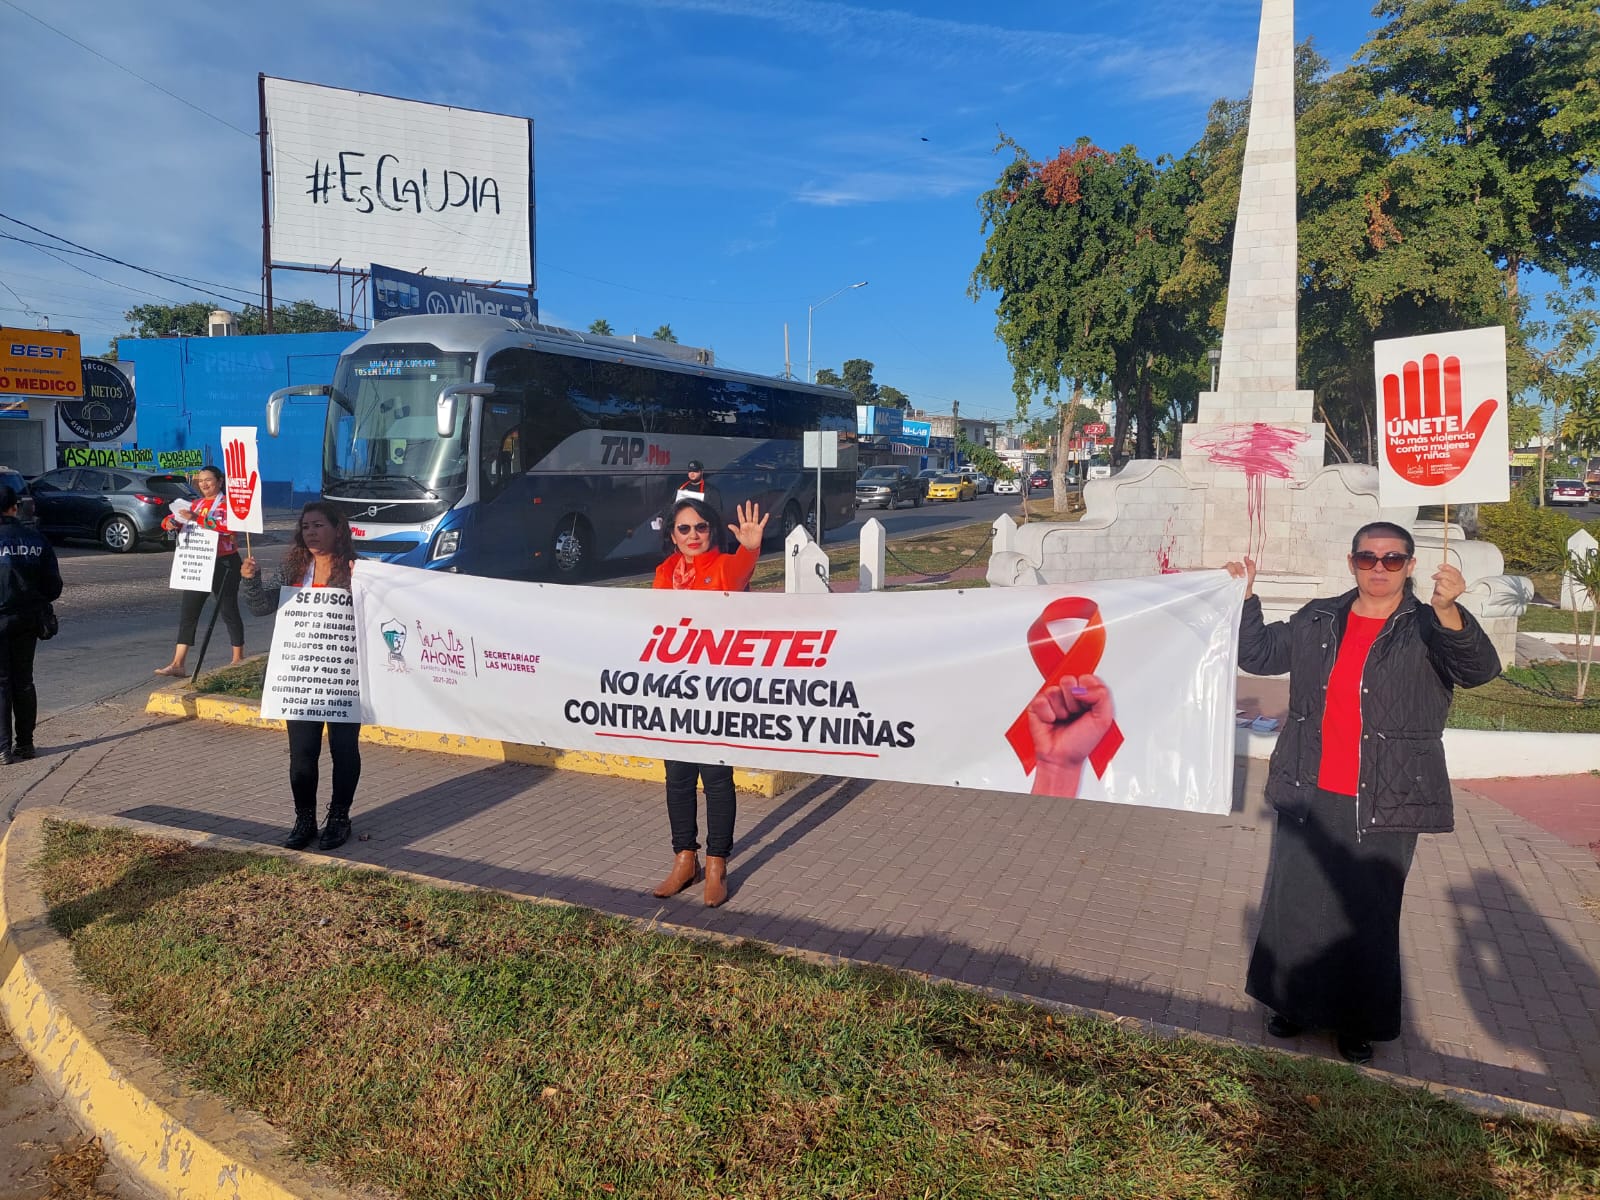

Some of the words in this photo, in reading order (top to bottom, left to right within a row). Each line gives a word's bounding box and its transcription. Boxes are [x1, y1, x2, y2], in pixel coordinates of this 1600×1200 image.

[10, 344, 67, 359] BEST
[15, 377, 77, 392] MEDICO
[91, 384, 123, 399] NIETOS
[902, 426, 928, 436] NI-LAB
[1387, 416, 1459, 437] ÚNETE
[1390, 437, 1405, 446] No
[1407, 434, 1428, 445] más
[1430, 431, 1476, 443] violencia
[600, 435, 645, 466] TAP
[1396, 443, 1428, 454] contra
[1430, 440, 1470, 452] mujeres
[66, 448, 117, 468] ASADA
[120, 448, 154, 462] BURROS
[159, 449, 203, 463] ADOBADA
[1415, 454, 1422, 463] y
[1423, 450, 1451, 460] niñas
[351, 526, 366, 537] Plus
[0, 545, 42, 557] ALIDAD
[295, 591, 311, 605] SE
[313, 592, 353, 607] BUSCA
[284, 609, 324, 619] Hombres
[326, 612, 344, 621] que
[294, 620, 310, 629] por
[312, 621, 321, 629] la
[323, 622, 356, 632] igualda
[295, 631, 306, 639] de
[308, 632, 350, 642] hombres
[639, 617, 838, 668] ¡ÚNETE!
[283, 641, 324, 651] mujeres
[326, 644, 338, 652] en
[281, 653, 296, 661] los
[298, 654, 342, 665] aspectos
[344, 657, 354, 665] de
[420, 649, 466, 670] AHOME
[321, 666, 339, 675] que
[485, 660, 499, 670] LAS
[501, 662, 536, 674] MUJERES
[277, 674, 344, 686] comprometan
[271, 685, 312, 694] eliminar
[314, 687, 323, 695] la
[326, 688, 360, 697] violenci
[600, 669, 639, 696] NO
[643, 670, 701, 701] MÁS
[705, 676, 860, 709] VIOLENCIA
[282, 696, 309, 705] hacia
[310, 698, 326, 707] las
[289, 707, 305, 716] las
[564, 699, 666, 732] CONTRA
[670, 707, 793, 742] MUJERES
[796, 715, 817, 743] Y
[820, 711, 915, 749] NIÑAS
